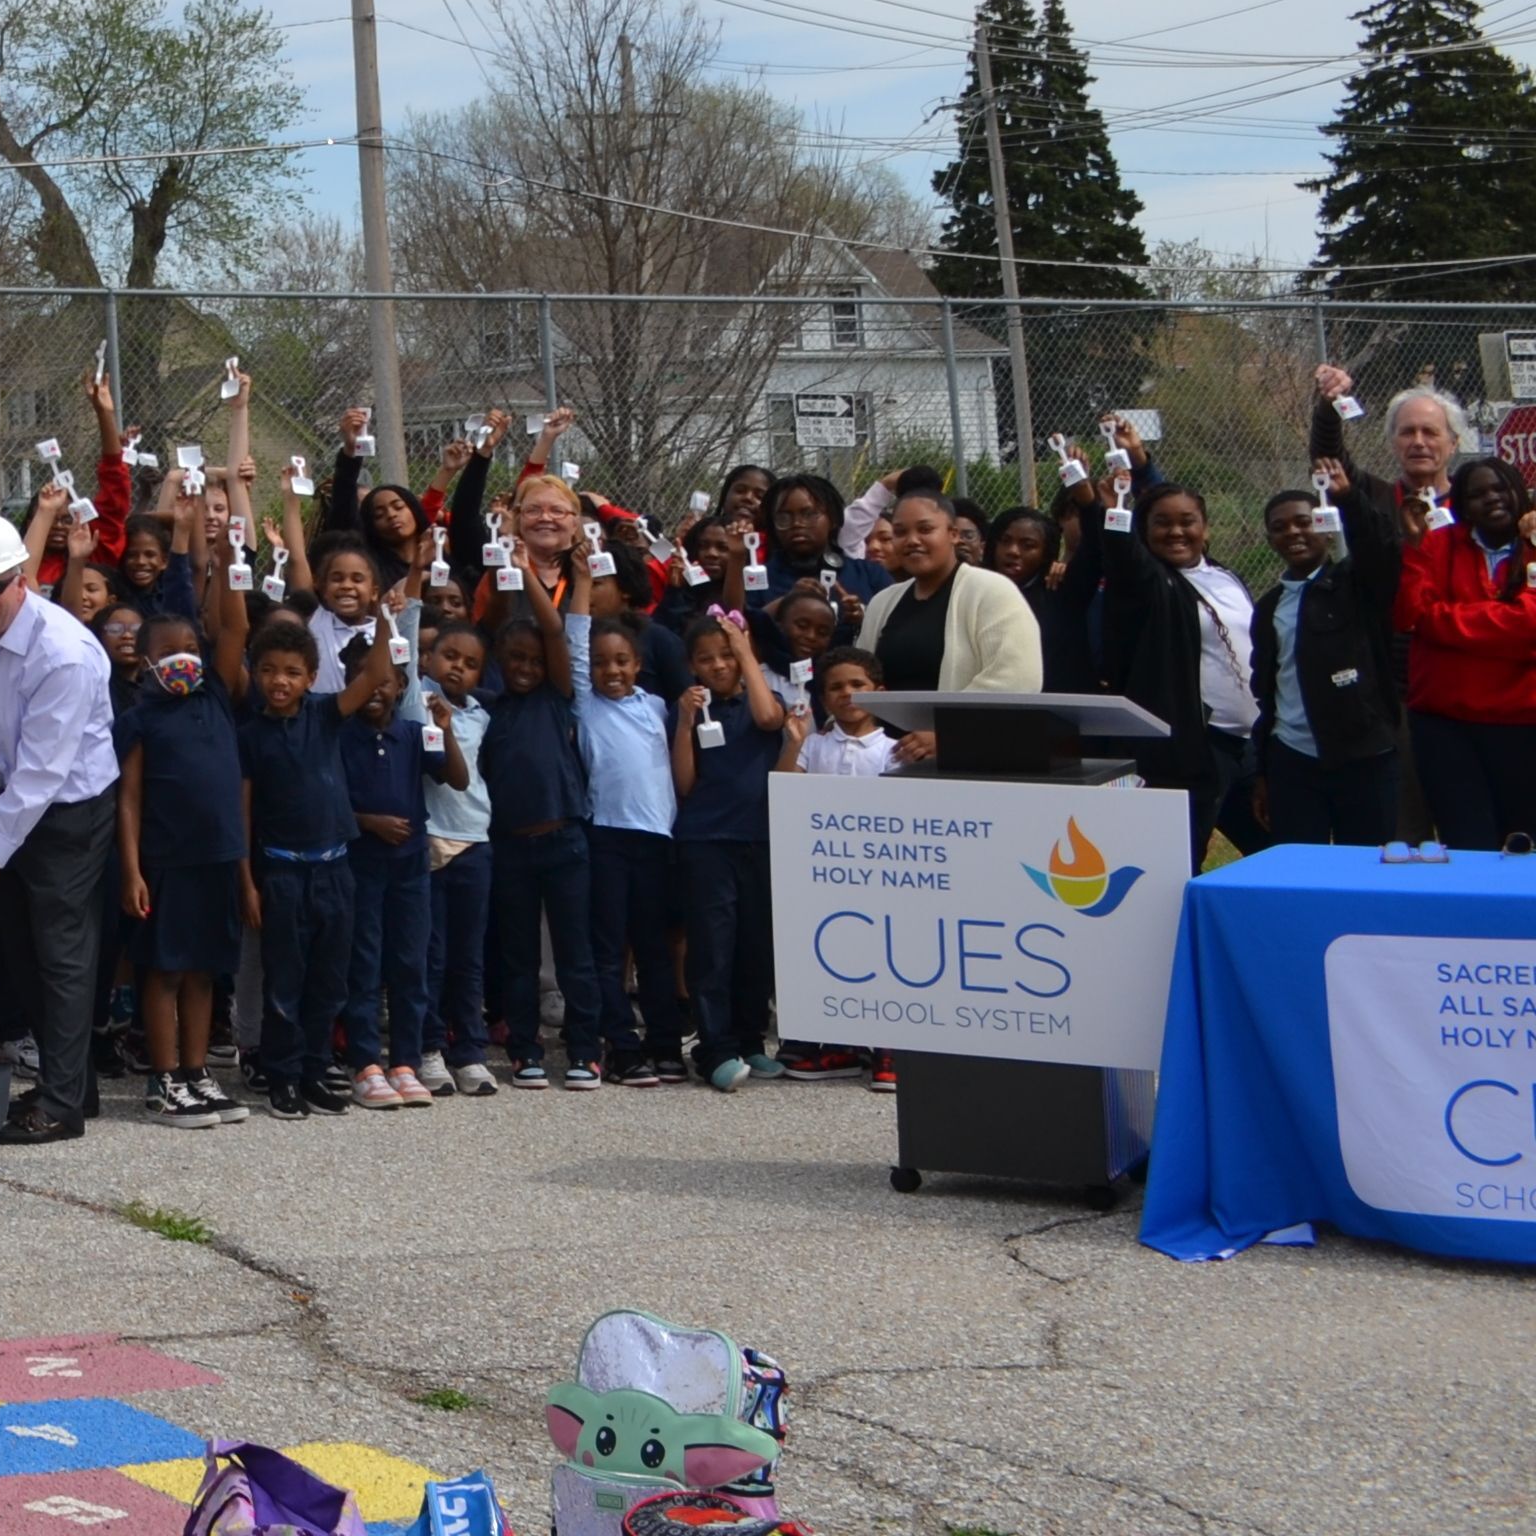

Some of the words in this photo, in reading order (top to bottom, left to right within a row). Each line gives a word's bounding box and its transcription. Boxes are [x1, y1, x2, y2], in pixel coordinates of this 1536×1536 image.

[810, 813, 904, 834] SACRED
[913, 818, 993, 839] HEART
[811, 840, 855, 858] ALL
[863, 842, 948, 863] SAINTS
[812, 866, 873, 885] HOLY
[882, 870, 951, 890] NAME
[814, 910, 1071, 998] CUES
[822, 995, 946, 1026] SCHOOL
[956, 1006, 1071, 1036] SYSTEM
[1439, 994, 1494, 1016] ALL
[1441, 1026, 1516, 1048] HOLY
